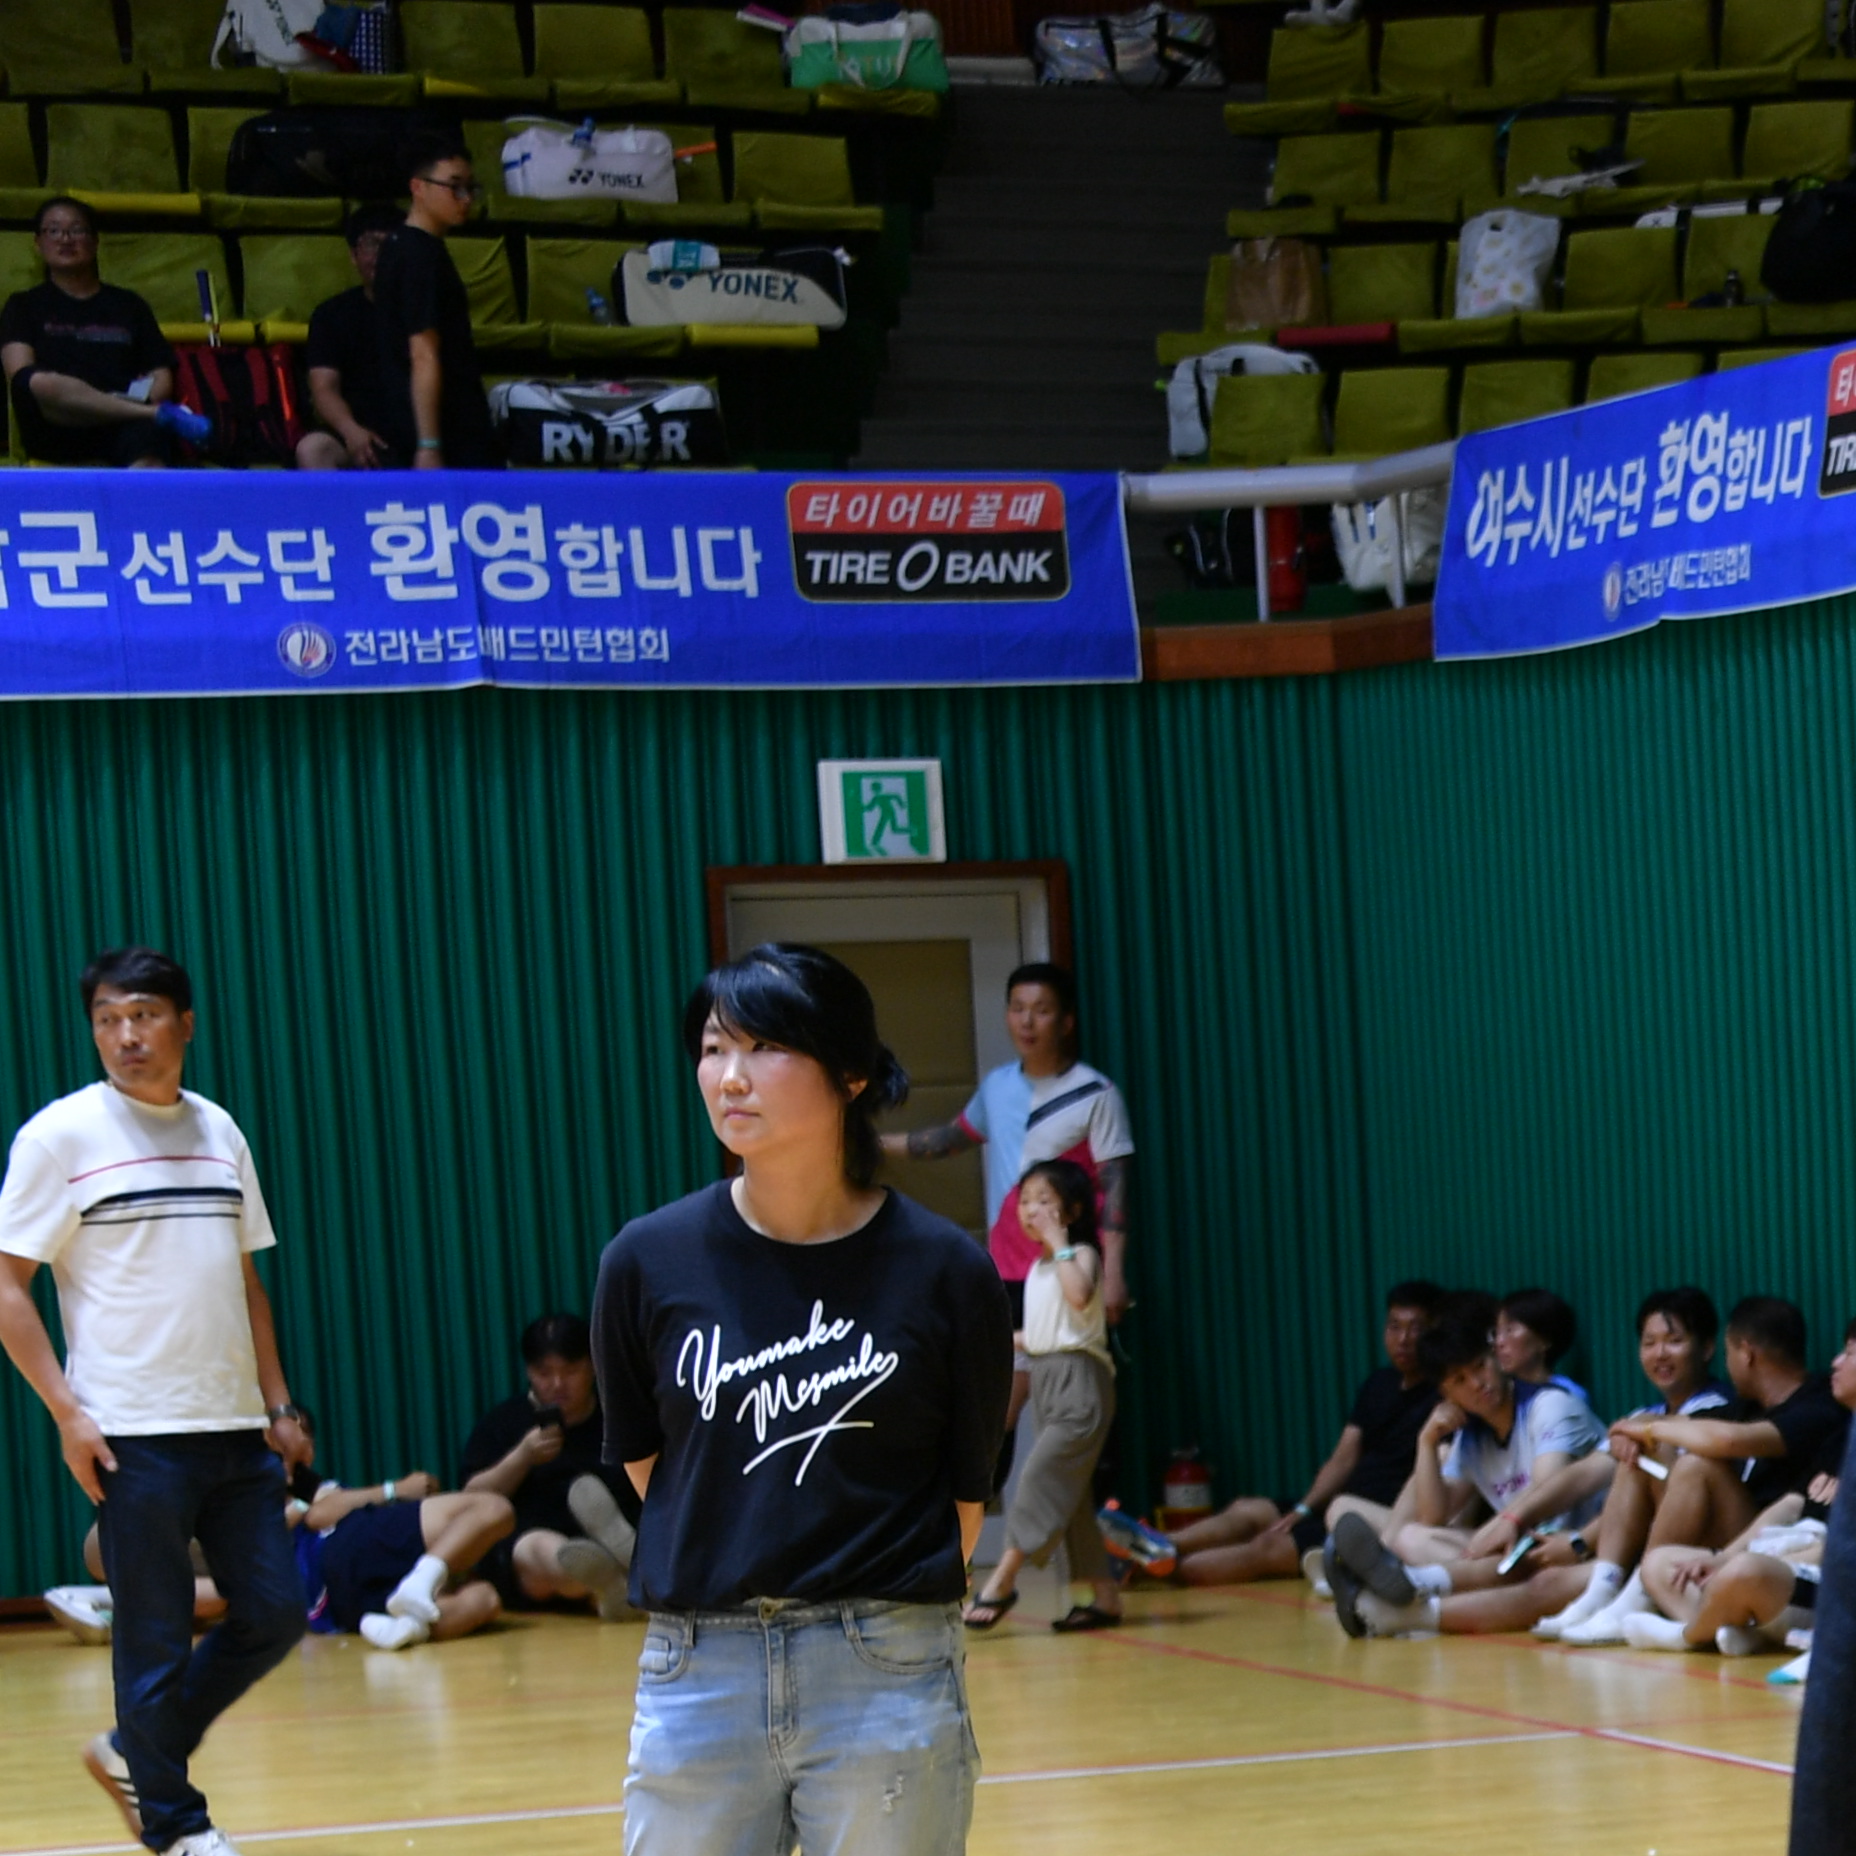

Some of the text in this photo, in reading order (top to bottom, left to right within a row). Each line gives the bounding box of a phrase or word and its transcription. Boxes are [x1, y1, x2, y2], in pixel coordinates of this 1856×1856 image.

[600, 171, 645, 189] YONEX
[707, 271, 800, 304] YONEX
[1566, 456, 1647, 551] 선수단
[1650, 411, 1813, 527] 환영합니다
[0, 502, 762, 609] 군 선수단 환영합니다
[805, 550, 893, 585] TIRE
[944, 549, 1053, 585] BANK
[345, 625, 670, 667] 전라남도배드민턴협회
